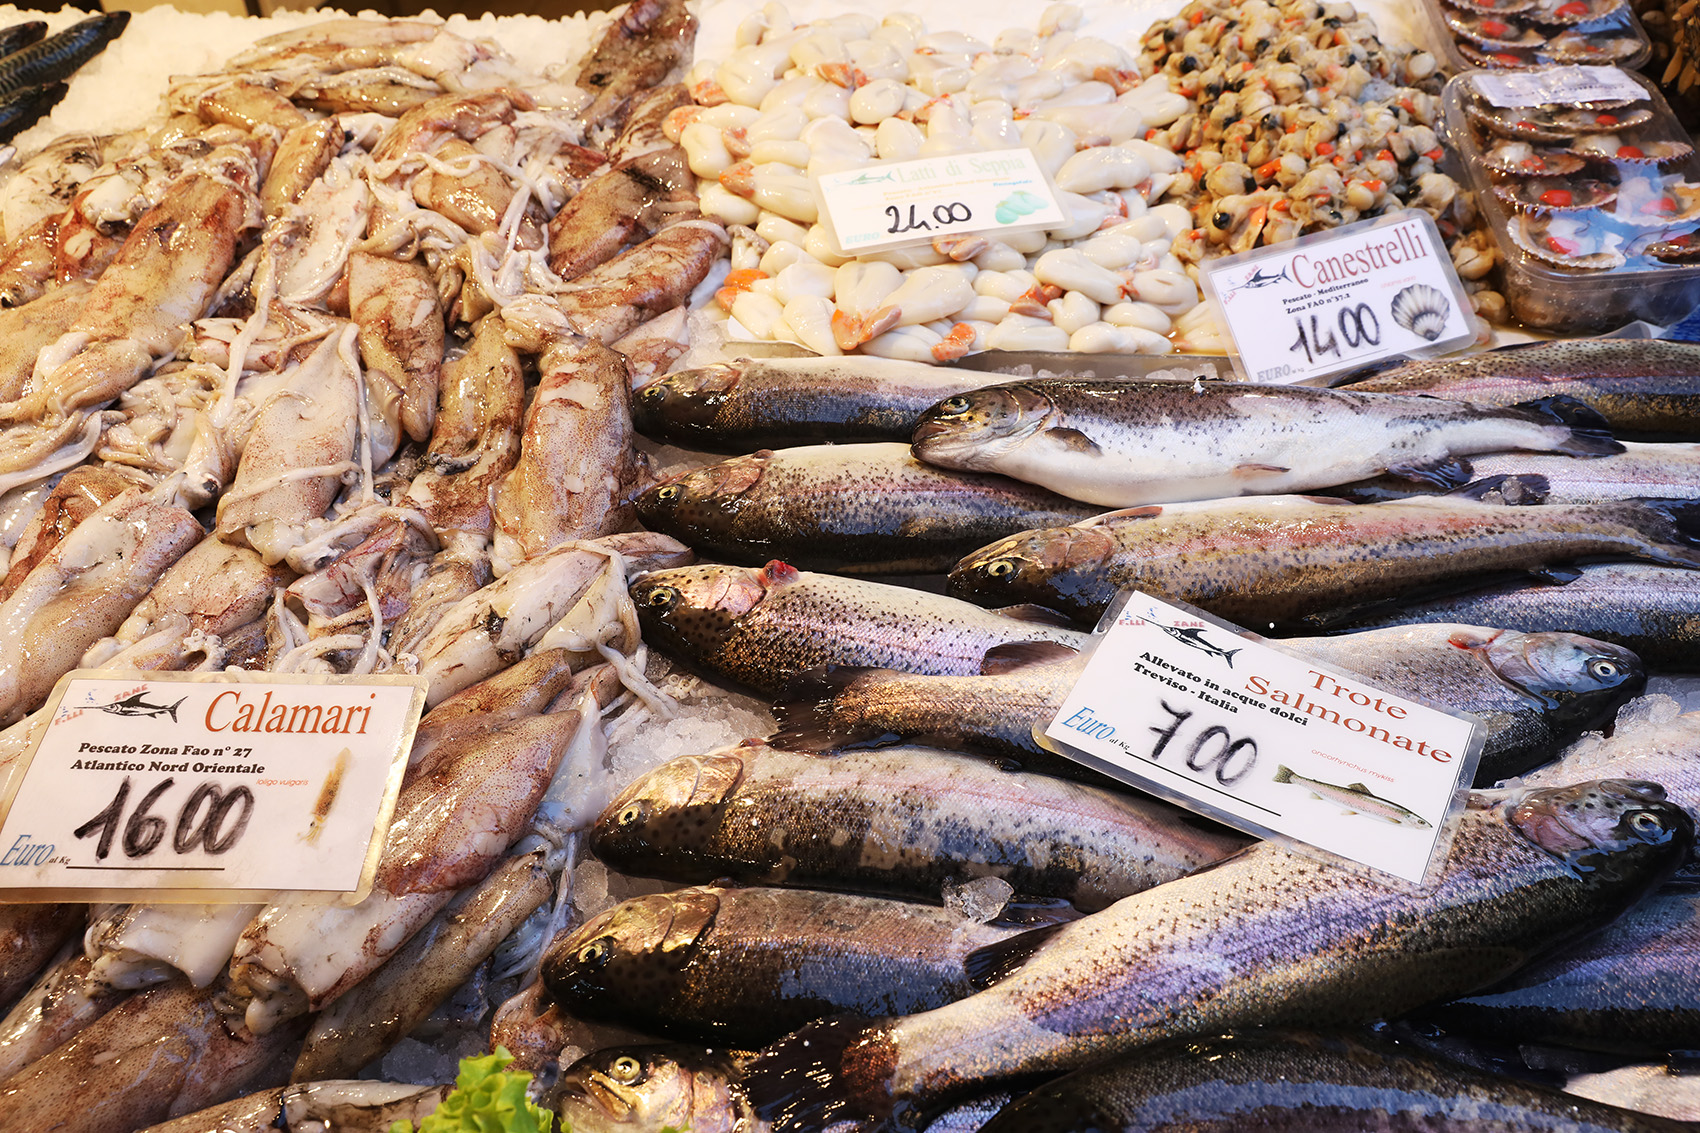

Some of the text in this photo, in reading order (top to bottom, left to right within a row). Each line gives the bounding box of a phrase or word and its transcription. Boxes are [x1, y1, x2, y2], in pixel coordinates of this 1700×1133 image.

[896, 154, 1026, 184] Latti di Seppia
[1291, 223, 1428, 289] Canestrelli
[1282, 293, 1312, 305] Pescato
[1317, 278, 1369, 296] Mediterraneo
[1286, 304, 1306, 315] Zona
[1307, 298, 1325, 309] FAO
[1257, 364, 1291, 382] EURO
[1133, 662, 1188, 693] Treviso
[1197, 690, 1238, 714] Italia
[1139, 651, 1309, 727] Allevato in acque dolci
[1308, 670, 1408, 720] Trote
[205, 691, 376, 735] Calamari
[1061, 706, 1116, 740] Euro
[1119, 741, 1131, 751] Kg
[1244, 675, 1453, 763] Salmonate
[78, 742, 253, 757] Pescato Zona Fao n° 27
[71, 759, 265, 775] Atlantico Nord Orientale
[279, 778, 309, 787] vulgaris
[1368, 769, 1395, 783] mykiss
[1, 834, 71, 867] Euro al Kg
